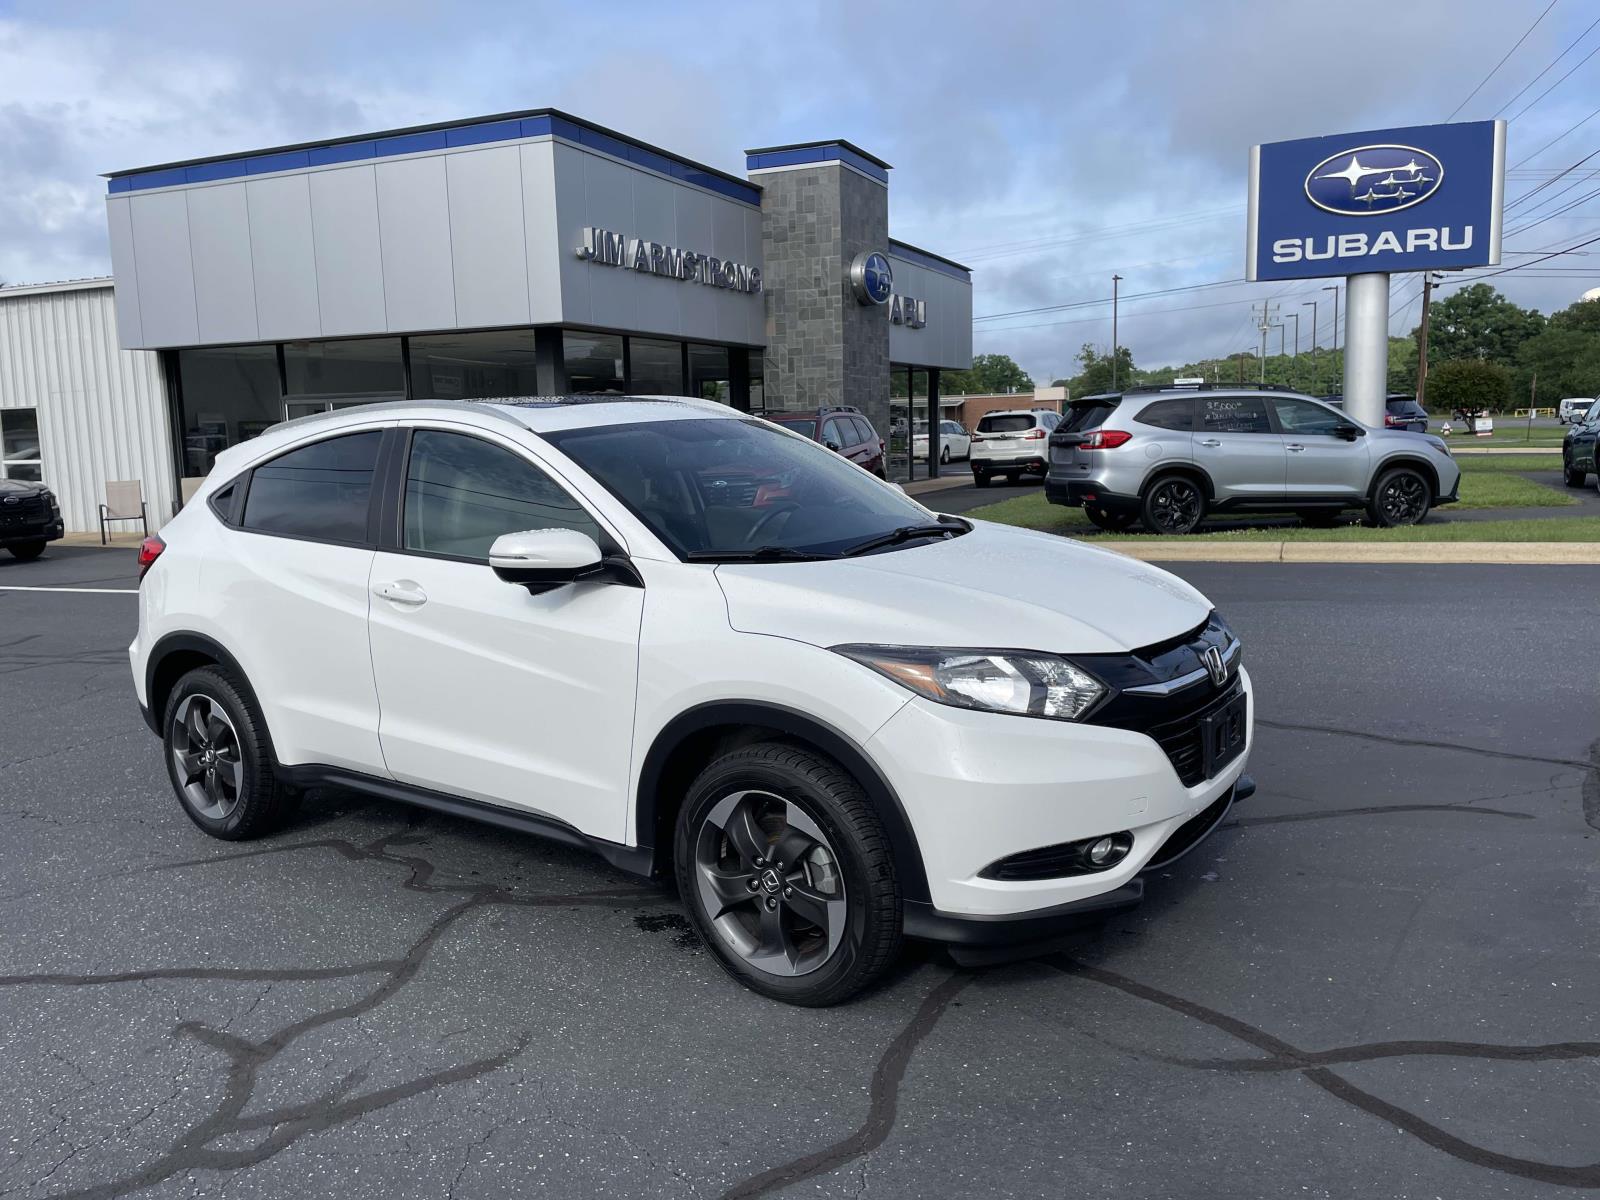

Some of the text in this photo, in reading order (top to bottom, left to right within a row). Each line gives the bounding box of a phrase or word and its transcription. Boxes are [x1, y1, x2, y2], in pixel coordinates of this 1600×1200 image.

[576, 226, 763, 293] JIM ARMSTRONG
[1273, 225, 1473, 263] SUBARU
